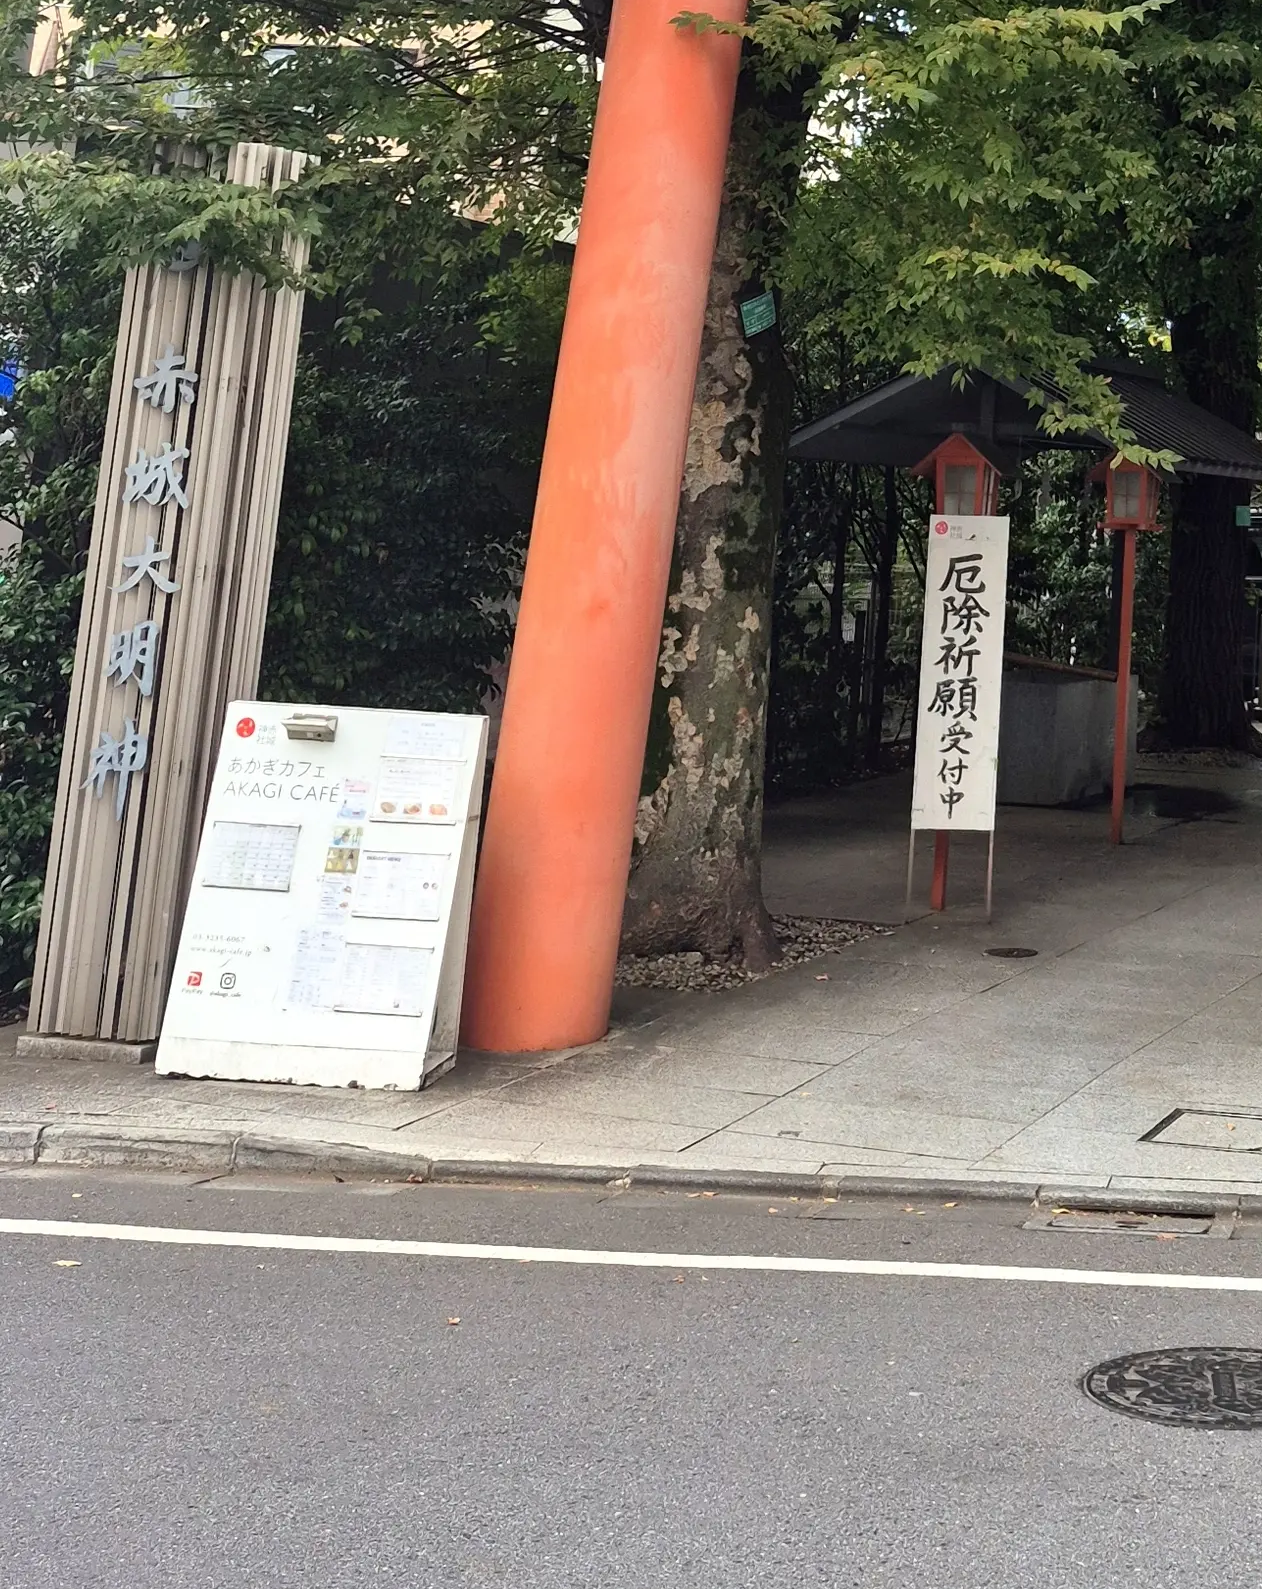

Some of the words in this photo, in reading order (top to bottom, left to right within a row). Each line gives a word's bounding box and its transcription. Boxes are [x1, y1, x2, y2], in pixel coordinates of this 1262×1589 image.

[927, 553, 990, 819] 厄除祈願受付中
[228, 757, 325, 778] あかぎカフェ
[223, 781, 283, 799] AKAGI
[290, 783, 340, 803] CAFÉ
